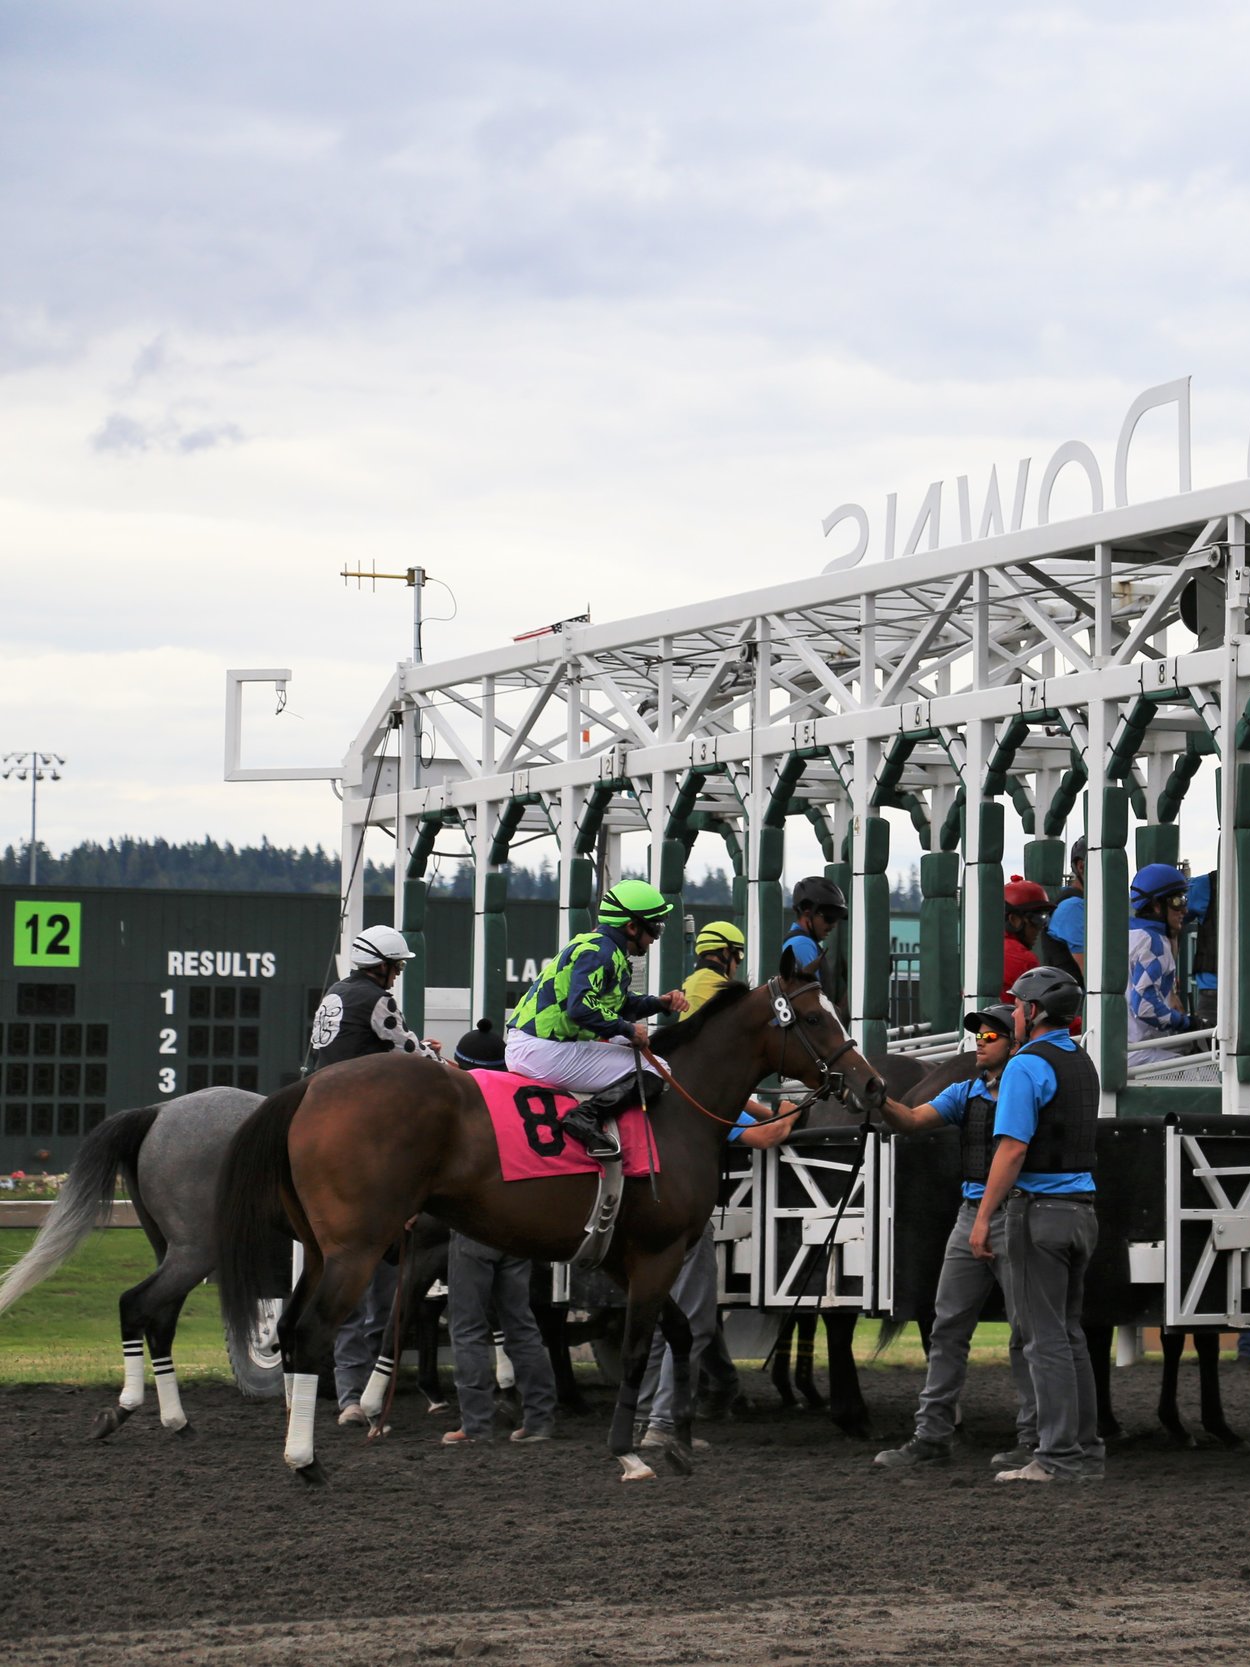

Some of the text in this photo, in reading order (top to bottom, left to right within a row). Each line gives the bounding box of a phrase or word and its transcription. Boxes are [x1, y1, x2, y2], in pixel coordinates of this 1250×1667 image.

[1158, 663, 1166, 684] 8
[1029, 686, 1037, 706] 7
[914, 706, 921, 726] 6
[803, 725, 810, 744] 5
[701, 743, 707, 761] 3
[605, 760, 612, 775] 2
[25, 914, 71, 955] 12
[168, 951, 276, 977] RESULTS
[160, 988, 174, 1015] 1
[774, 997, 792, 1022] 8
[159, 1028, 177, 1054] 2
[158, 1067, 176, 1093] 3
[513, 1085, 566, 1157] 8
